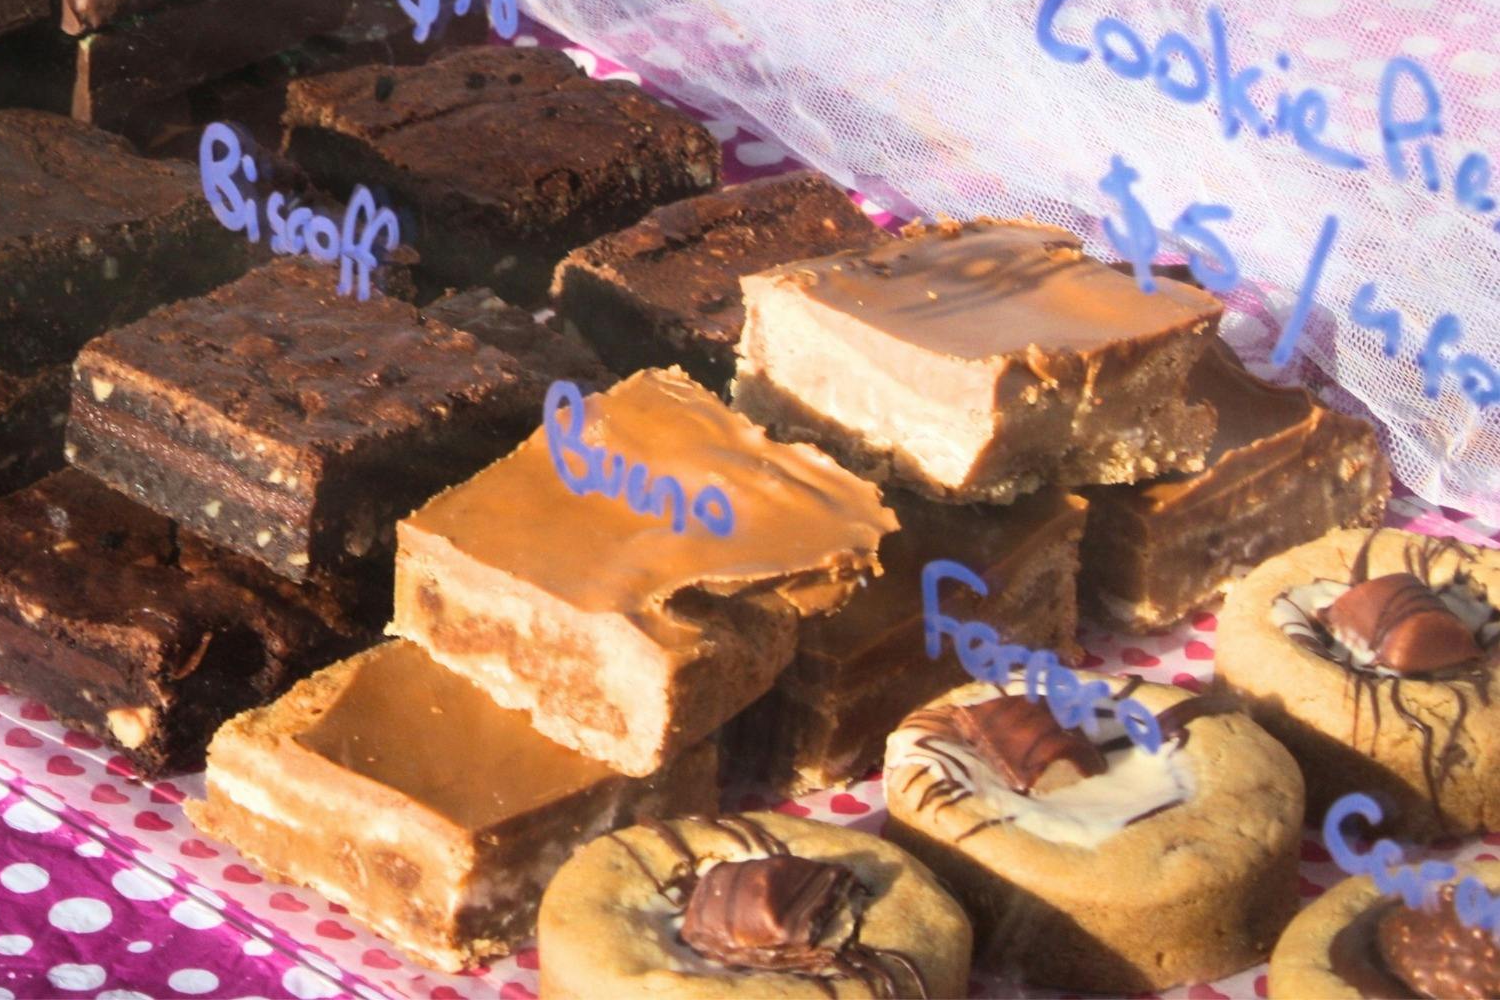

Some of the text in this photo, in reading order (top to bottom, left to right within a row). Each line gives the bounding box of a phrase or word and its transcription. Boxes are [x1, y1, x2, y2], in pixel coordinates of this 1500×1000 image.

[200, 121, 400, 301] Biscoff
[1379, 55, 1500, 234] Pie
[543, 381, 736, 538] Bueno
